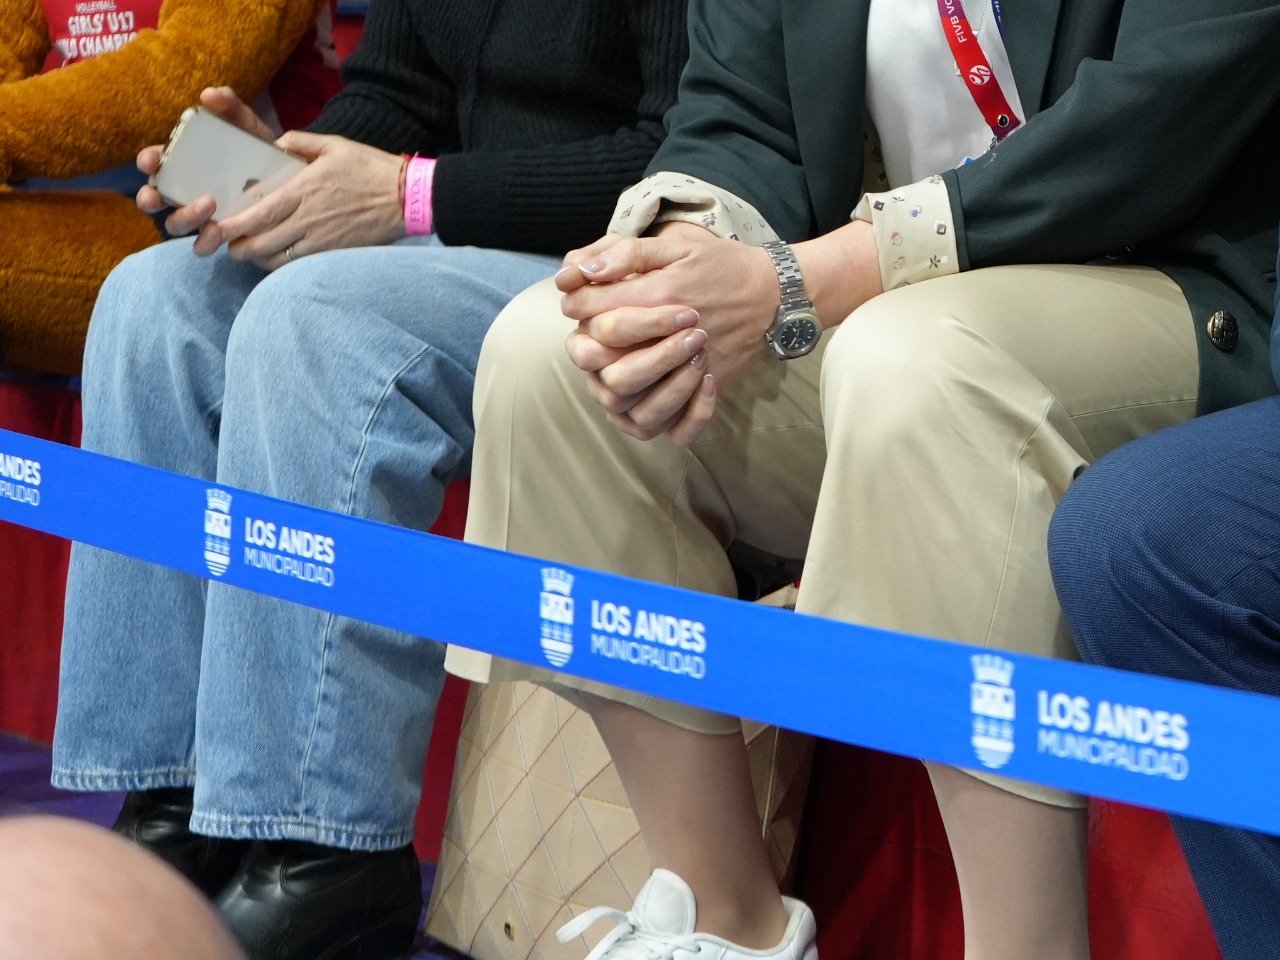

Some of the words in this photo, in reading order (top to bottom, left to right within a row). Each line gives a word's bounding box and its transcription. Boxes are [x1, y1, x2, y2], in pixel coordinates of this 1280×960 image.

[68, 13, 104, 38] GIRLS'
[107, 10, 135, 33] U17
[75, 0, 117, 15] VOLLEYBALL
[949, 15, 968, 44] FIVB
[244, 517, 276, 549] LOS
[277, 525, 336, 565] ANDES
[244, 544, 336, 588] MUNICIPALIDAD
[590, 598, 631, 635] LOS
[633, 609, 707, 653] ANDES
[590, 631, 707, 680] MUNICIPALIDAD
[1036, 689, 1091, 731] LOS
[1093, 699, 1190, 752] ANDES
[1036, 728, 1189, 781] MUNICIPALIDAD
